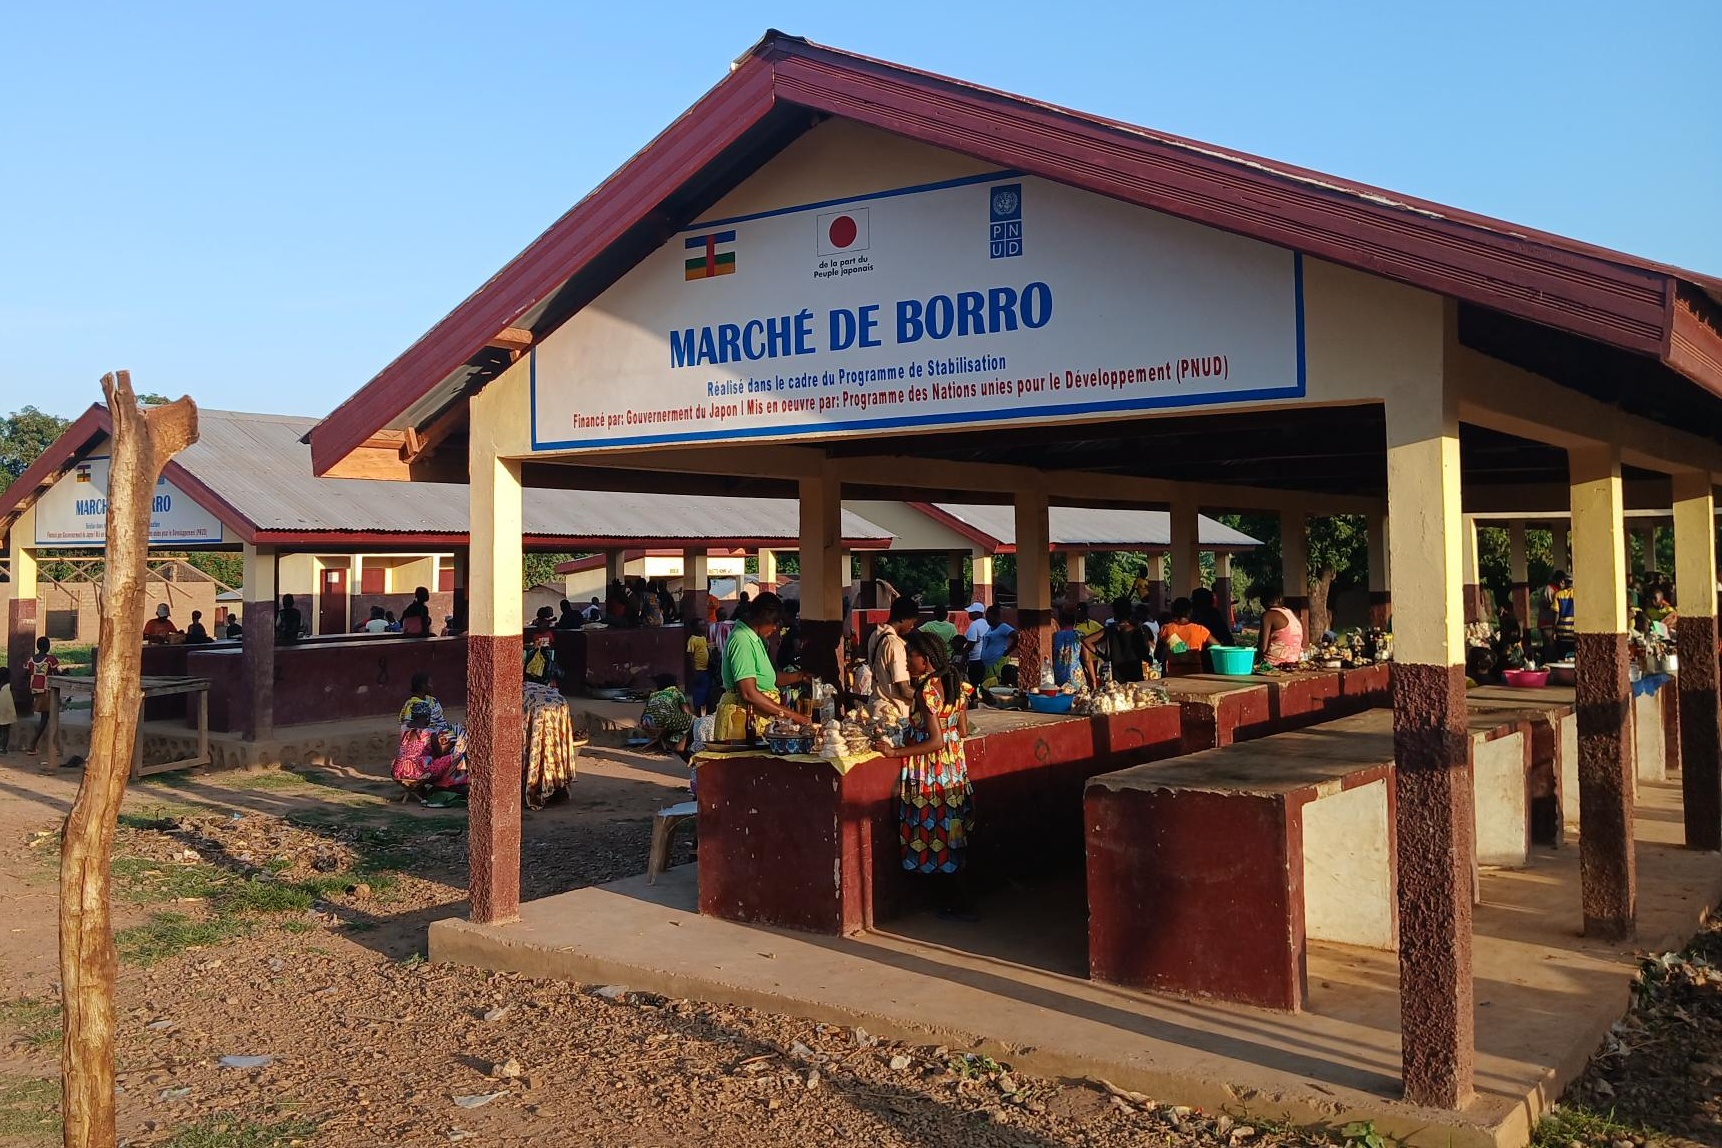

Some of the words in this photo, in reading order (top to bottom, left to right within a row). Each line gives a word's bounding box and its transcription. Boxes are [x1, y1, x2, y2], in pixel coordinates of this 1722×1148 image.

[813, 267, 839, 279] Peuple
[840, 263, 874, 277] japonais
[818, 261, 829, 269] de
[830, 259, 838, 268] la
[839, 257, 856, 268] part
[857, 255, 869, 264] du
[669, 308, 816, 369] MARCHÉ
[829, 304, 882, 352] DE
[896, 281, 1053, 344] BORRO
[707, 378, 745, 397] Réalisé
[747, 377, 772, 394] dans
[775, 375, 785, 391] le
[788, 372, 819, 389] cadre
[822, 371, 836, 387] du
[838, 366, 905, 388] Programme
[908, 362, 923, 377] de
[927, 354, 1007, 377] Stabilisation
[573, 411, 605, 429] Financé
[607, 415, 625, 431] par:
[695, 403, 707, 420] du
[709, 402, 738, 422] Japon
[747, 398, 764, 416] Mis
[766, 397, 778, 413] en
[782, 395, 816, 413] oeuvre
[819, 395, 840, 414] par:
[842, 388, 904, 410] Programme
[908, 384, 928, 402] des
[932, 378, 977, 401] Nations
[980, 377, 1013, 397] unies
[1017, 375, 1046, 398] pour
[1049, 373, 1061, 391] le
[1065, 362, 1172, 390] Développement
[1176, 354, 1229, 384] (PNUD)
[76, 499, 108, 516] MARCH
